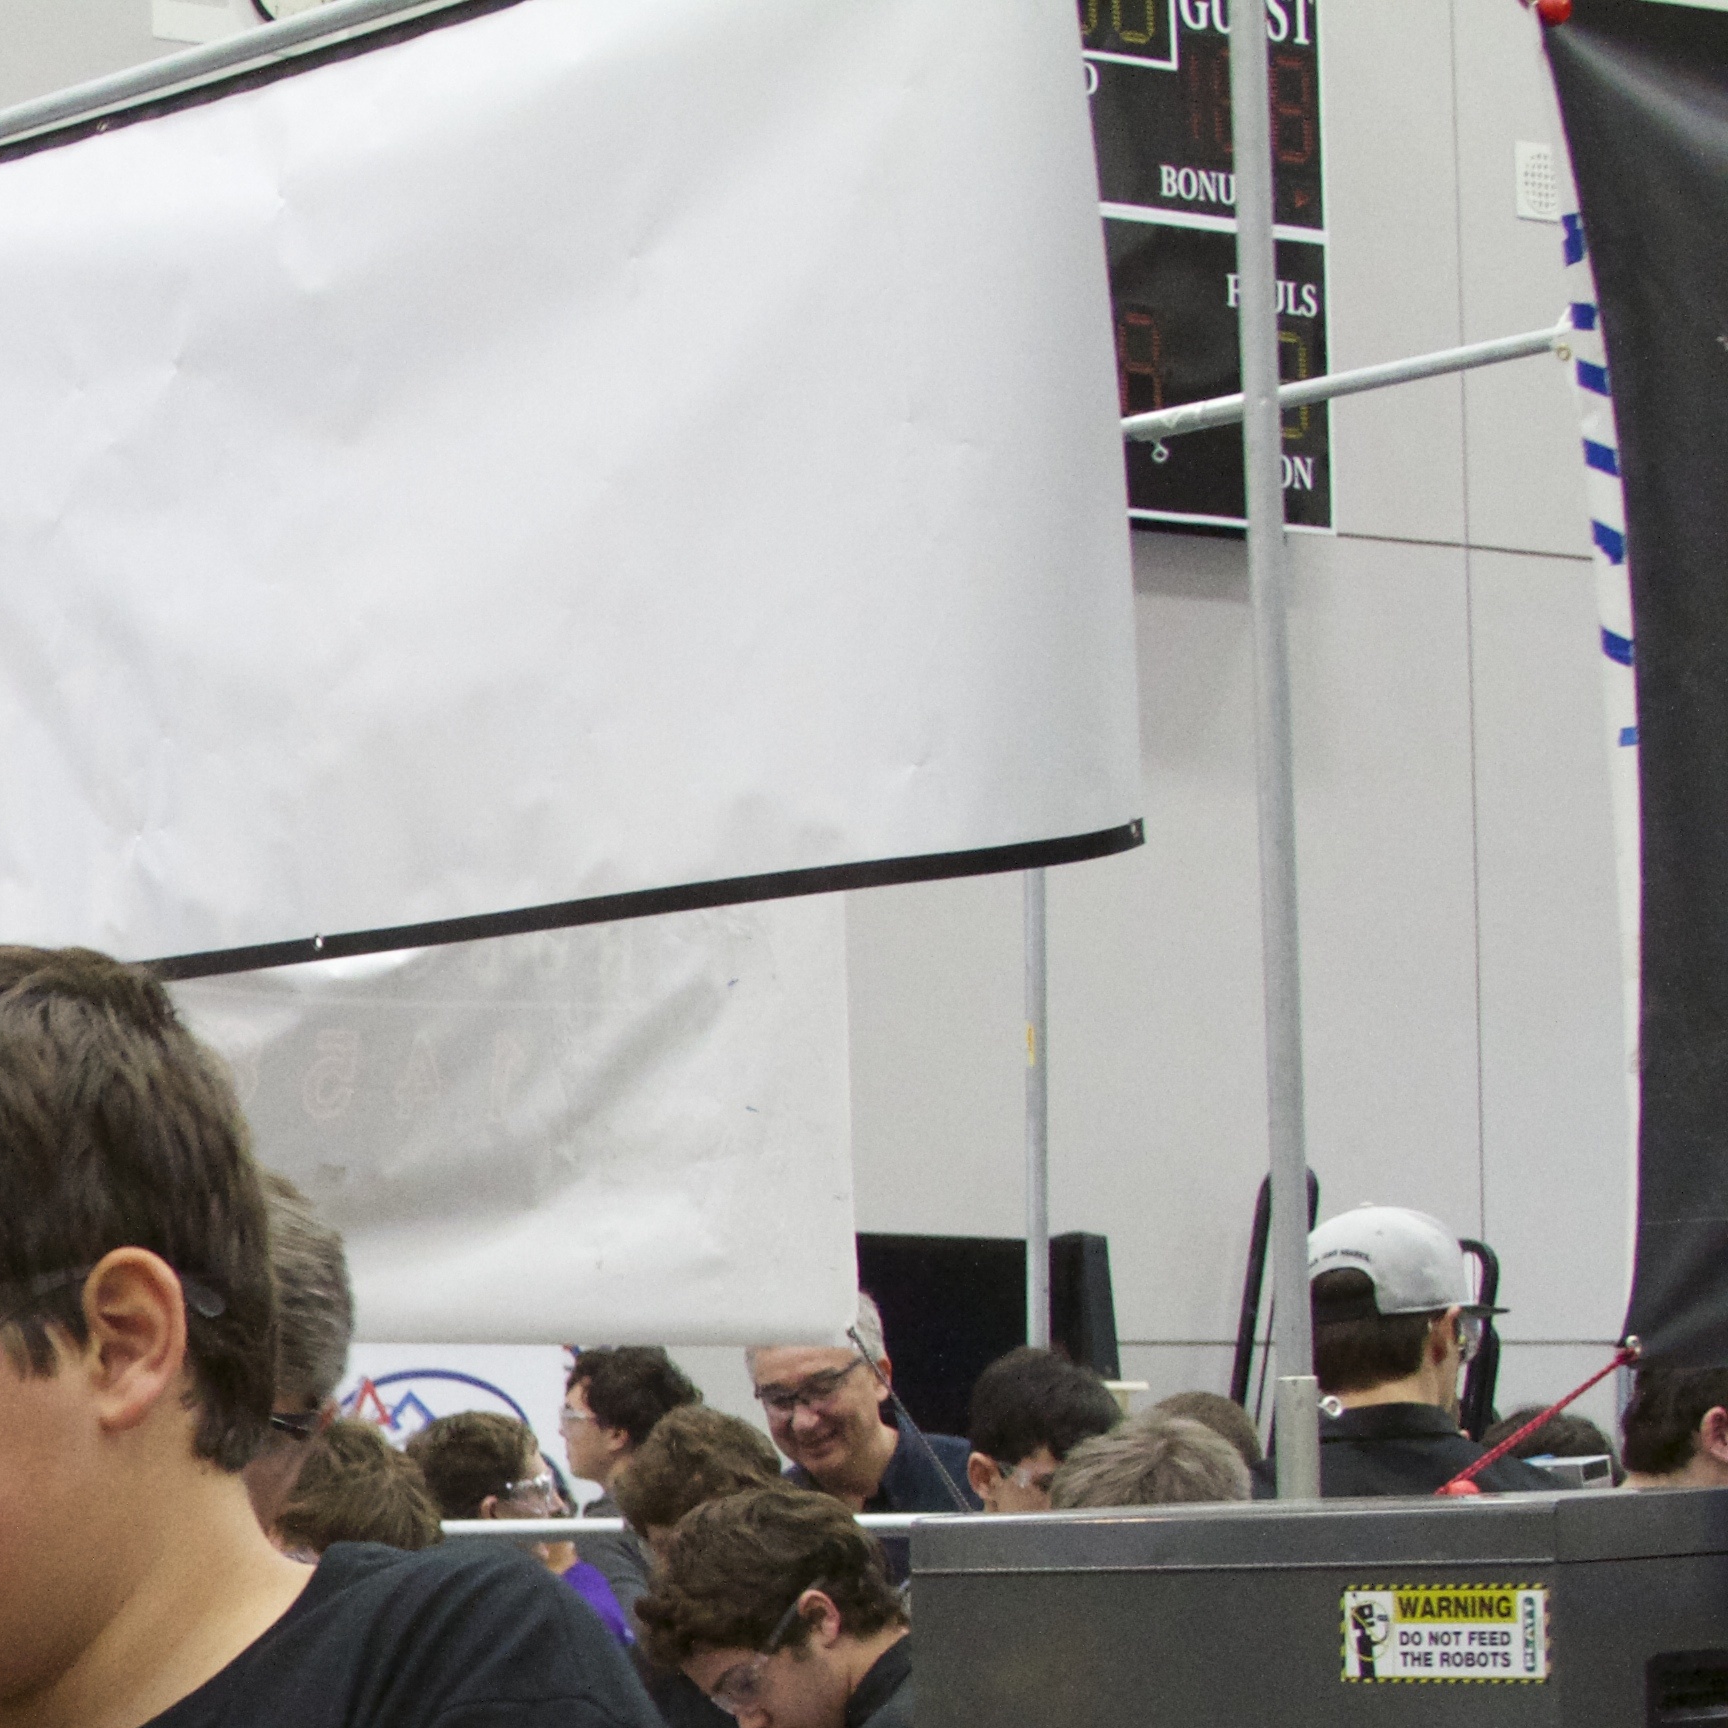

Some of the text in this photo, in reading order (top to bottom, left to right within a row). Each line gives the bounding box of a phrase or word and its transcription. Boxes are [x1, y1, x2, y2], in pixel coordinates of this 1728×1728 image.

[1399, 1596, 1512, 1619] WARNING
[1399, 1631, 1512, 1646] DO NOT FEED
[1401, 1652, 1512, 1668] THE ROBOTS
